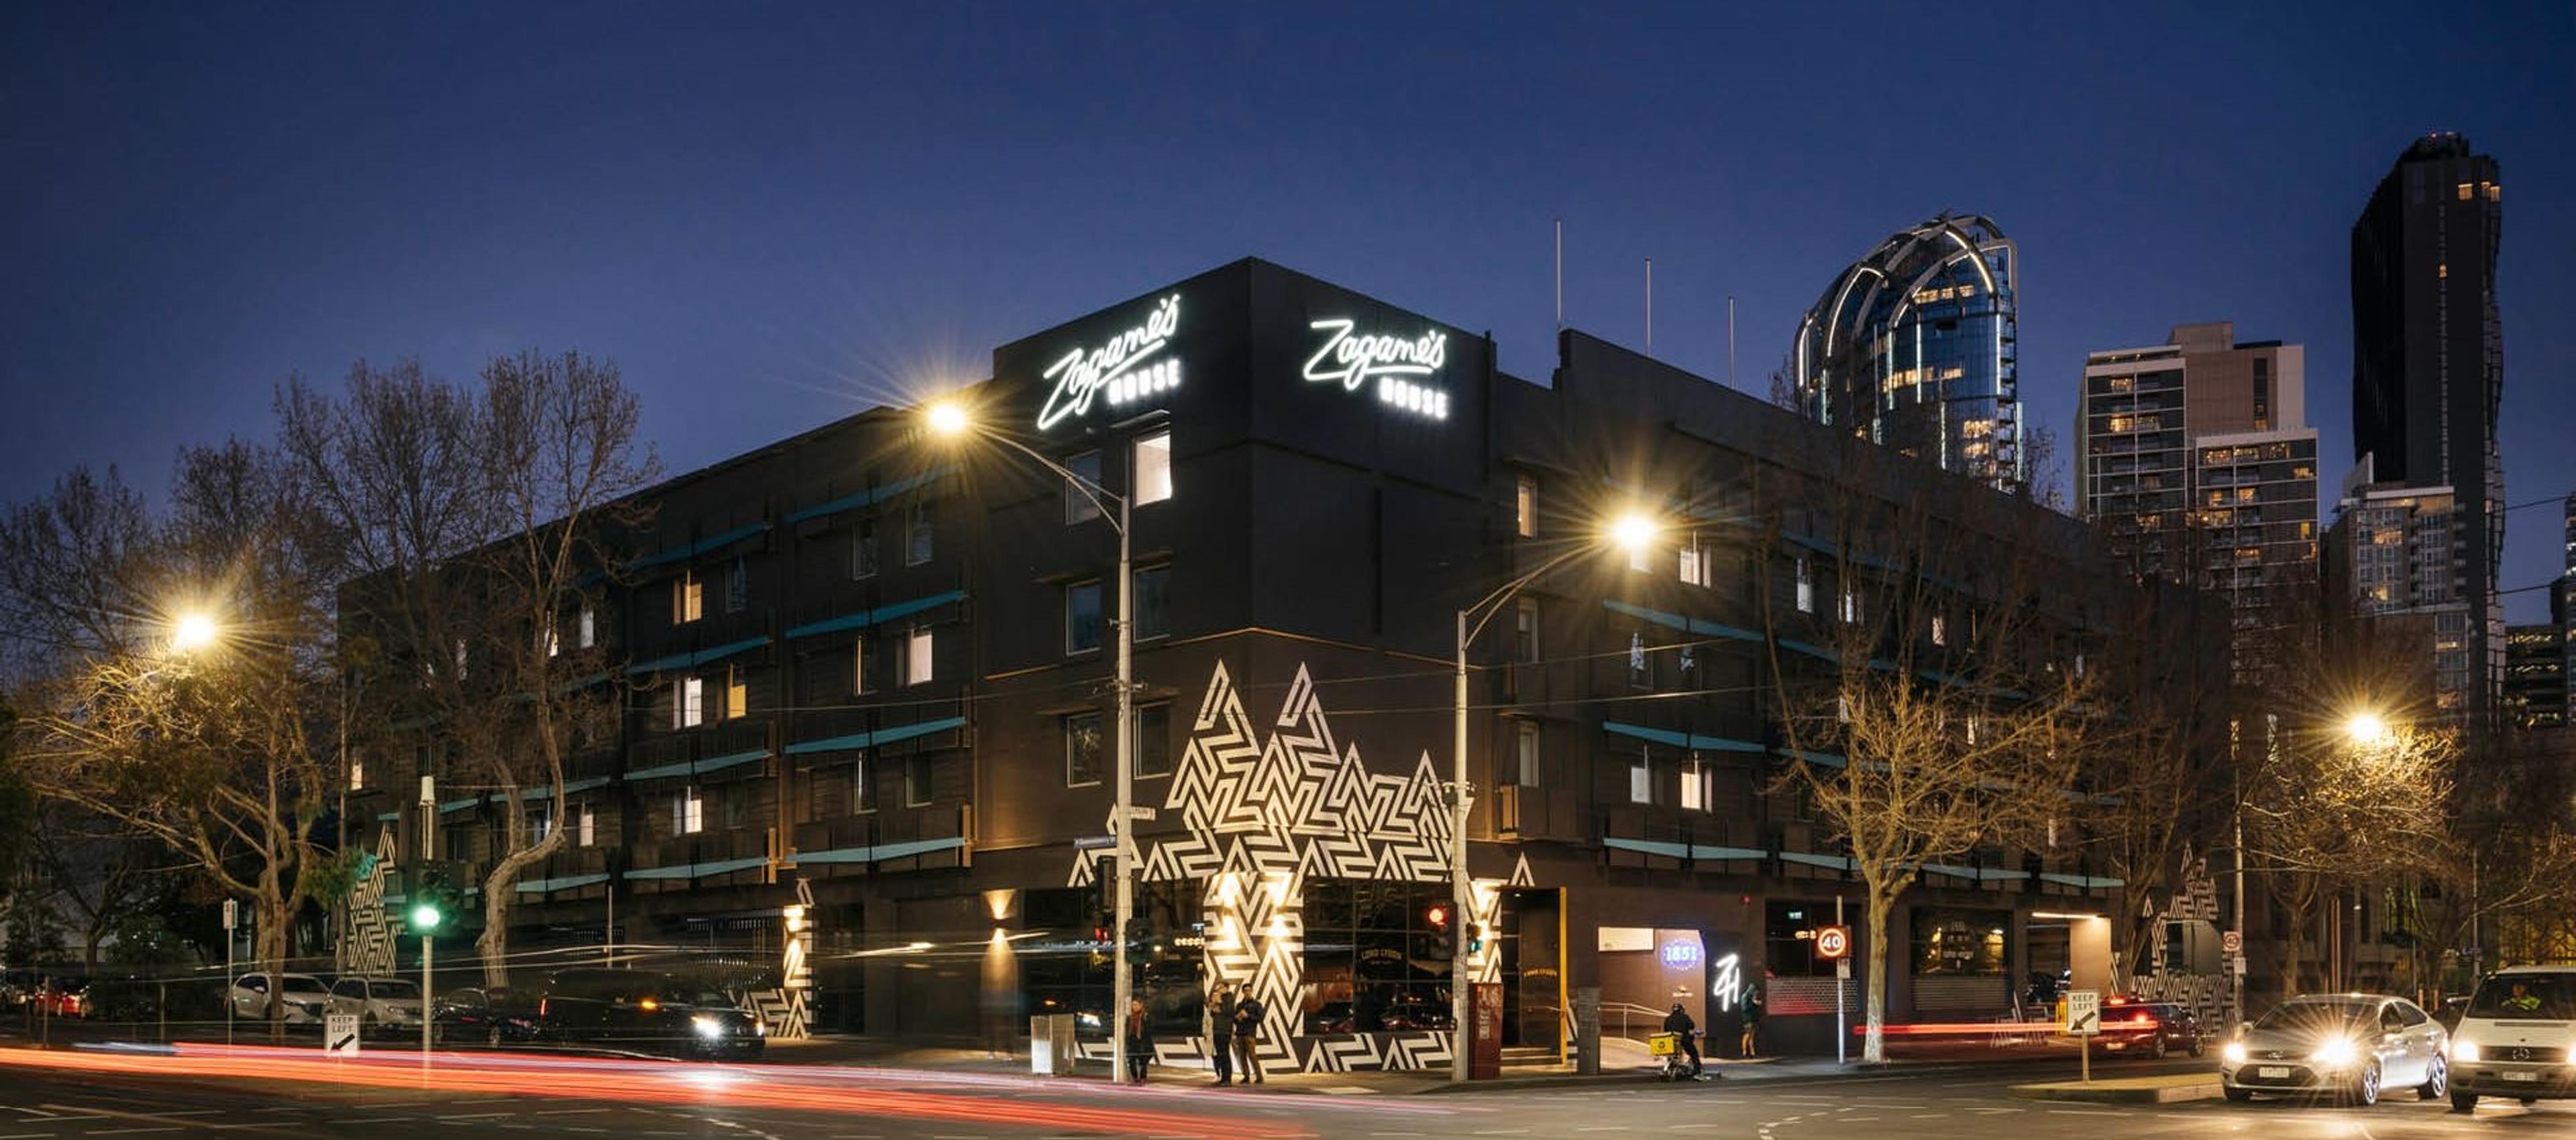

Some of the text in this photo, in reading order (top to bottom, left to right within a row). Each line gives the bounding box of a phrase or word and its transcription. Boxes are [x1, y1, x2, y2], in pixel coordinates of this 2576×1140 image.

[1037, 293, 1181, 431] Zagame's
[1303, 319, 1447, 391] Zagame's
[1107, 357, 1180, 404] HOUSE
[1379, 376, 1448, 418] HOUSE
[1823, 935, 1841, 948] 40
[1664, 946, 1697, 962] 1851
[2073, 1003, 2093, 1011] LEFT
[332, 1016, 354, 1024] KEEP
[332, 1025, 353, 1033] LEFT
